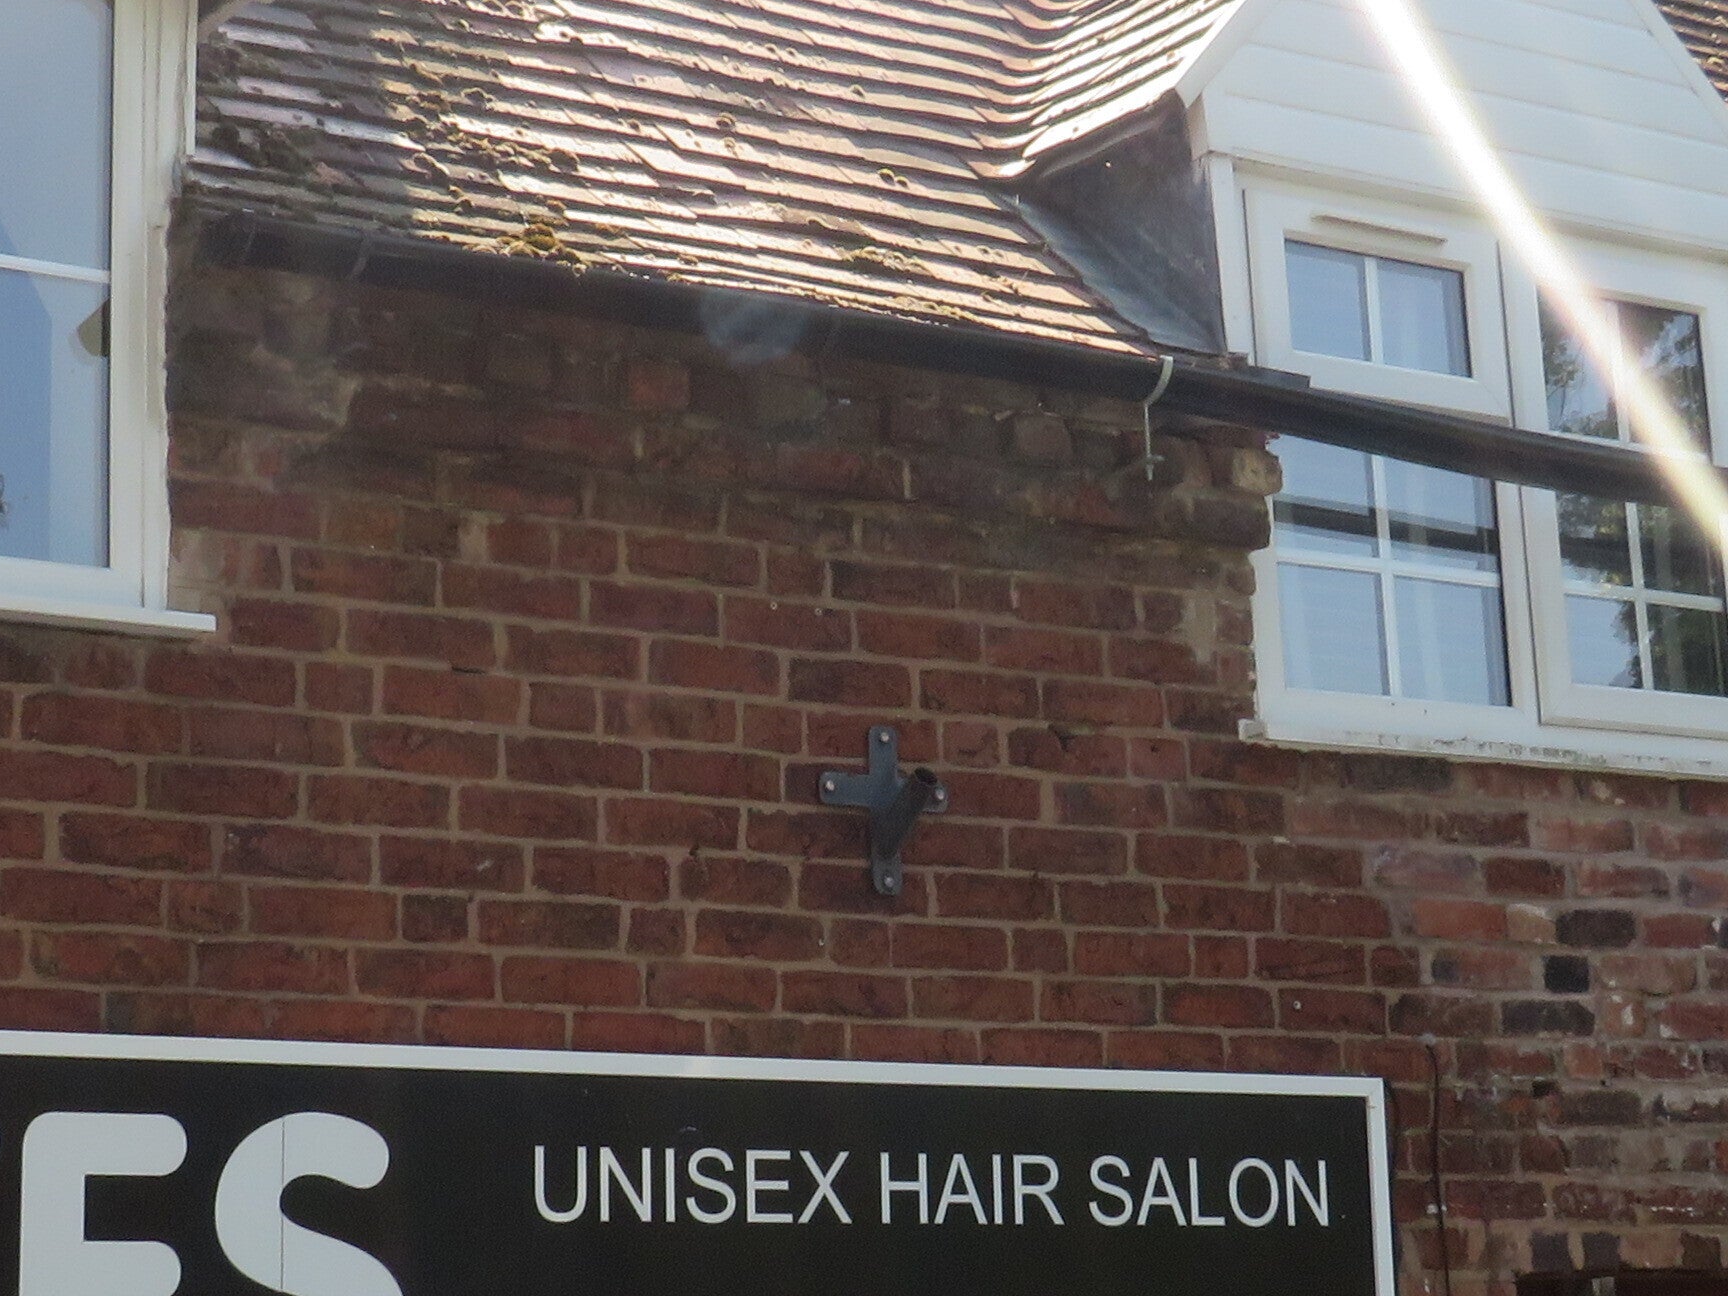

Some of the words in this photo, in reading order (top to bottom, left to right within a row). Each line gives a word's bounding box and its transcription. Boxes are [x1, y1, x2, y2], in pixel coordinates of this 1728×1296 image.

[532, 1144, 853, 1224] UNISEX
[879, 1151, 1066, 1226] HAIR
[1087, 1155, 1330, 1228] SALON
